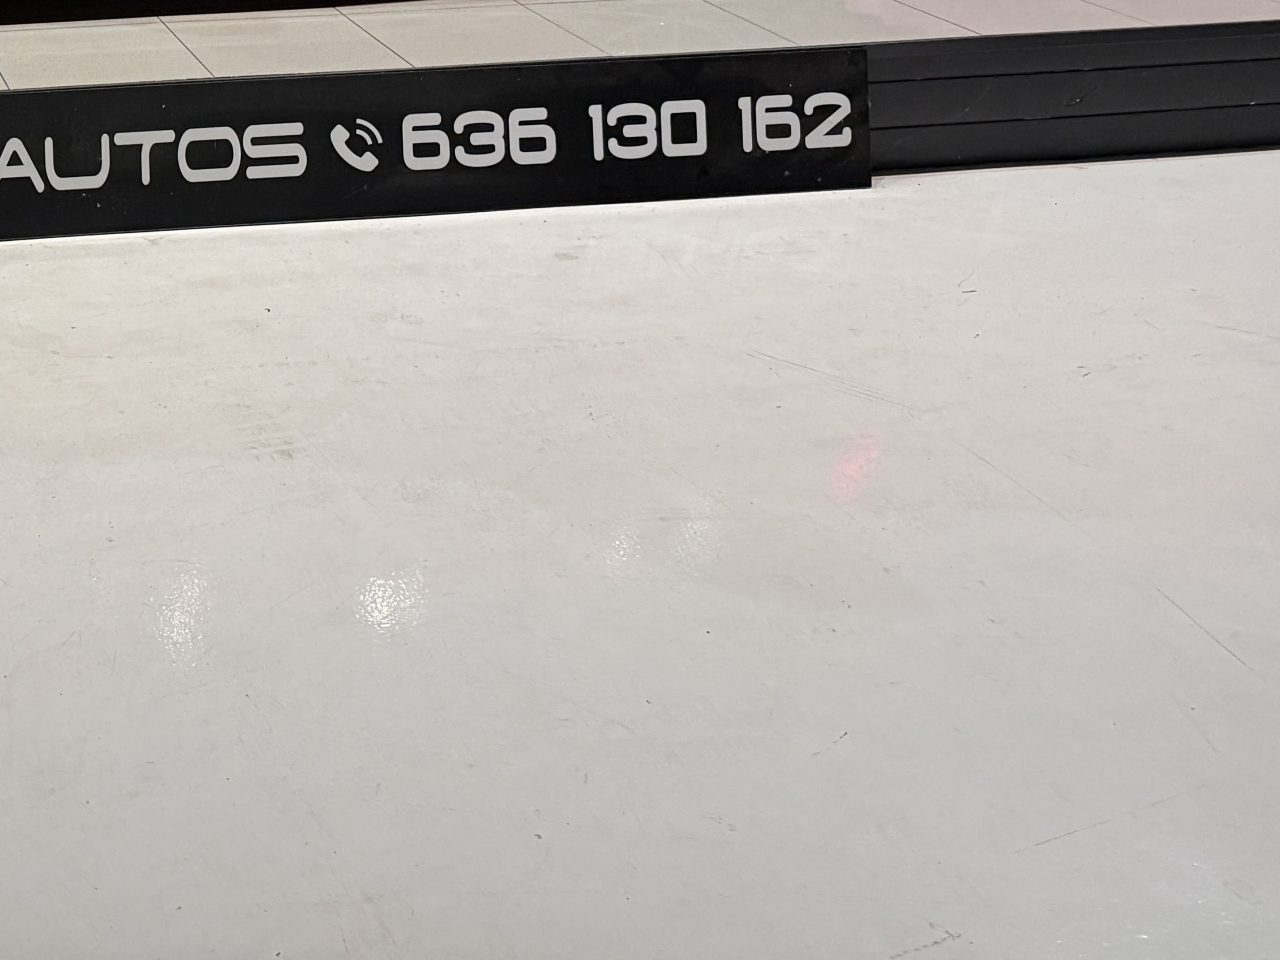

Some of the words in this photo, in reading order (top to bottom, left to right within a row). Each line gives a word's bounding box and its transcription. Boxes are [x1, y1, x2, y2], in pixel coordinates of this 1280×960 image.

[401, 106, 557, 171] 636
[588, 99, 708, 161] 130
[737, 91, 852, 153] 162
